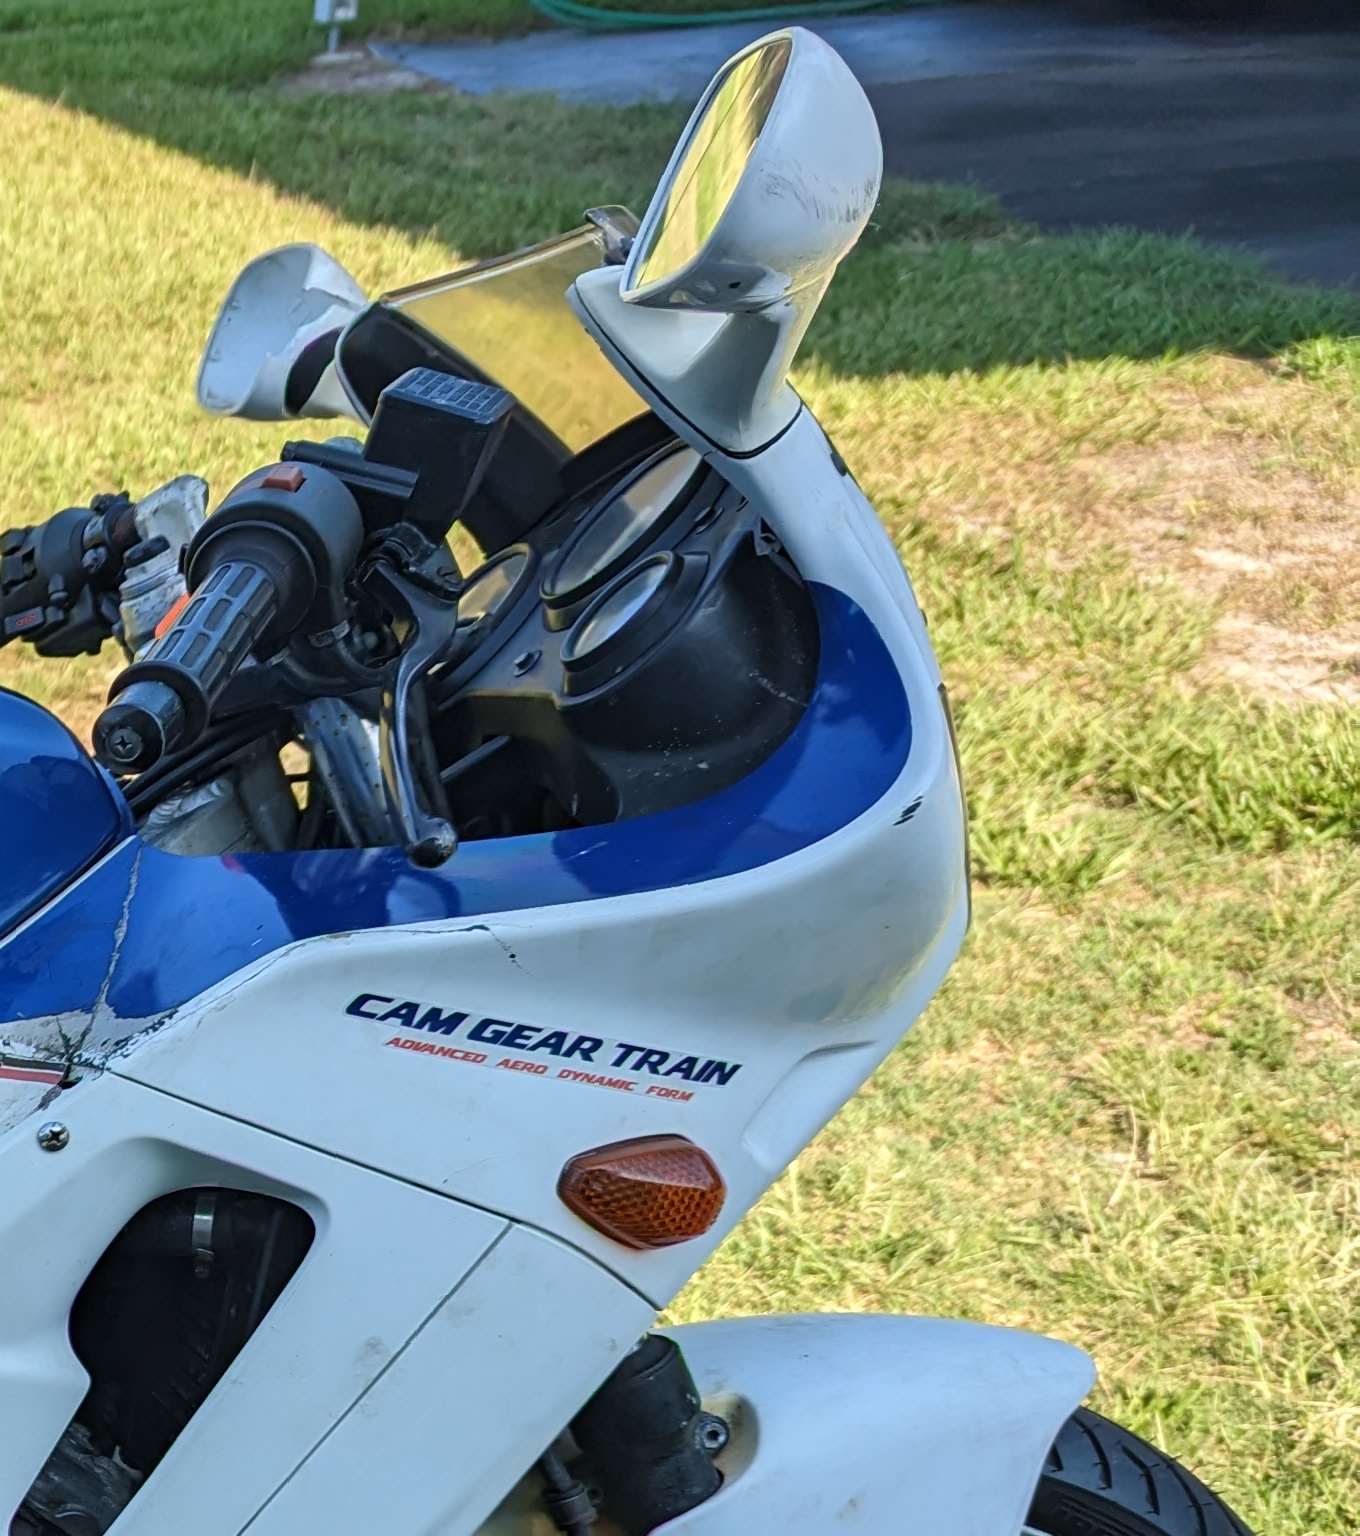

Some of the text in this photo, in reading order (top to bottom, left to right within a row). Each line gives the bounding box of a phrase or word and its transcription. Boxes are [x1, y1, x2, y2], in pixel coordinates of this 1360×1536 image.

[345, 993, 742, 1085] CAM GEAR TRAIN
[385, 1036, 694, 1102] ADVANCED AERO DYNAMIC FORM
